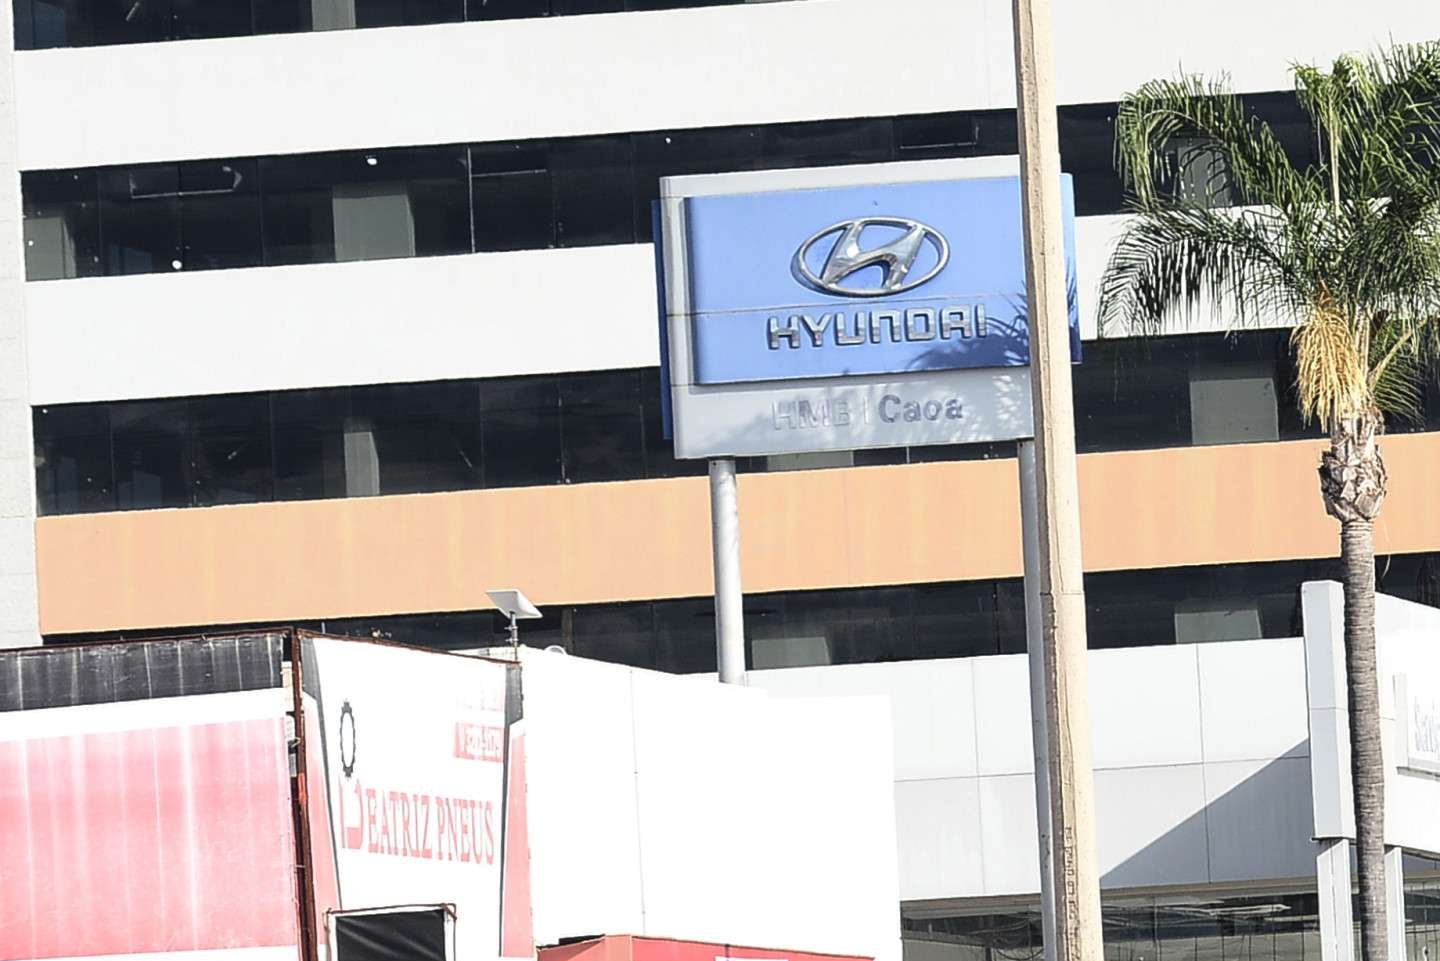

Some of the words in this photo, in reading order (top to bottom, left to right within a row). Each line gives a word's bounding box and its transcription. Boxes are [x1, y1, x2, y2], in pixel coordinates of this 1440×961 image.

[768, 303, 987, 350] HYUNDAI
[878, 394, 964, 425] Caoa
[436, 796, 496, 865] PNEUS
